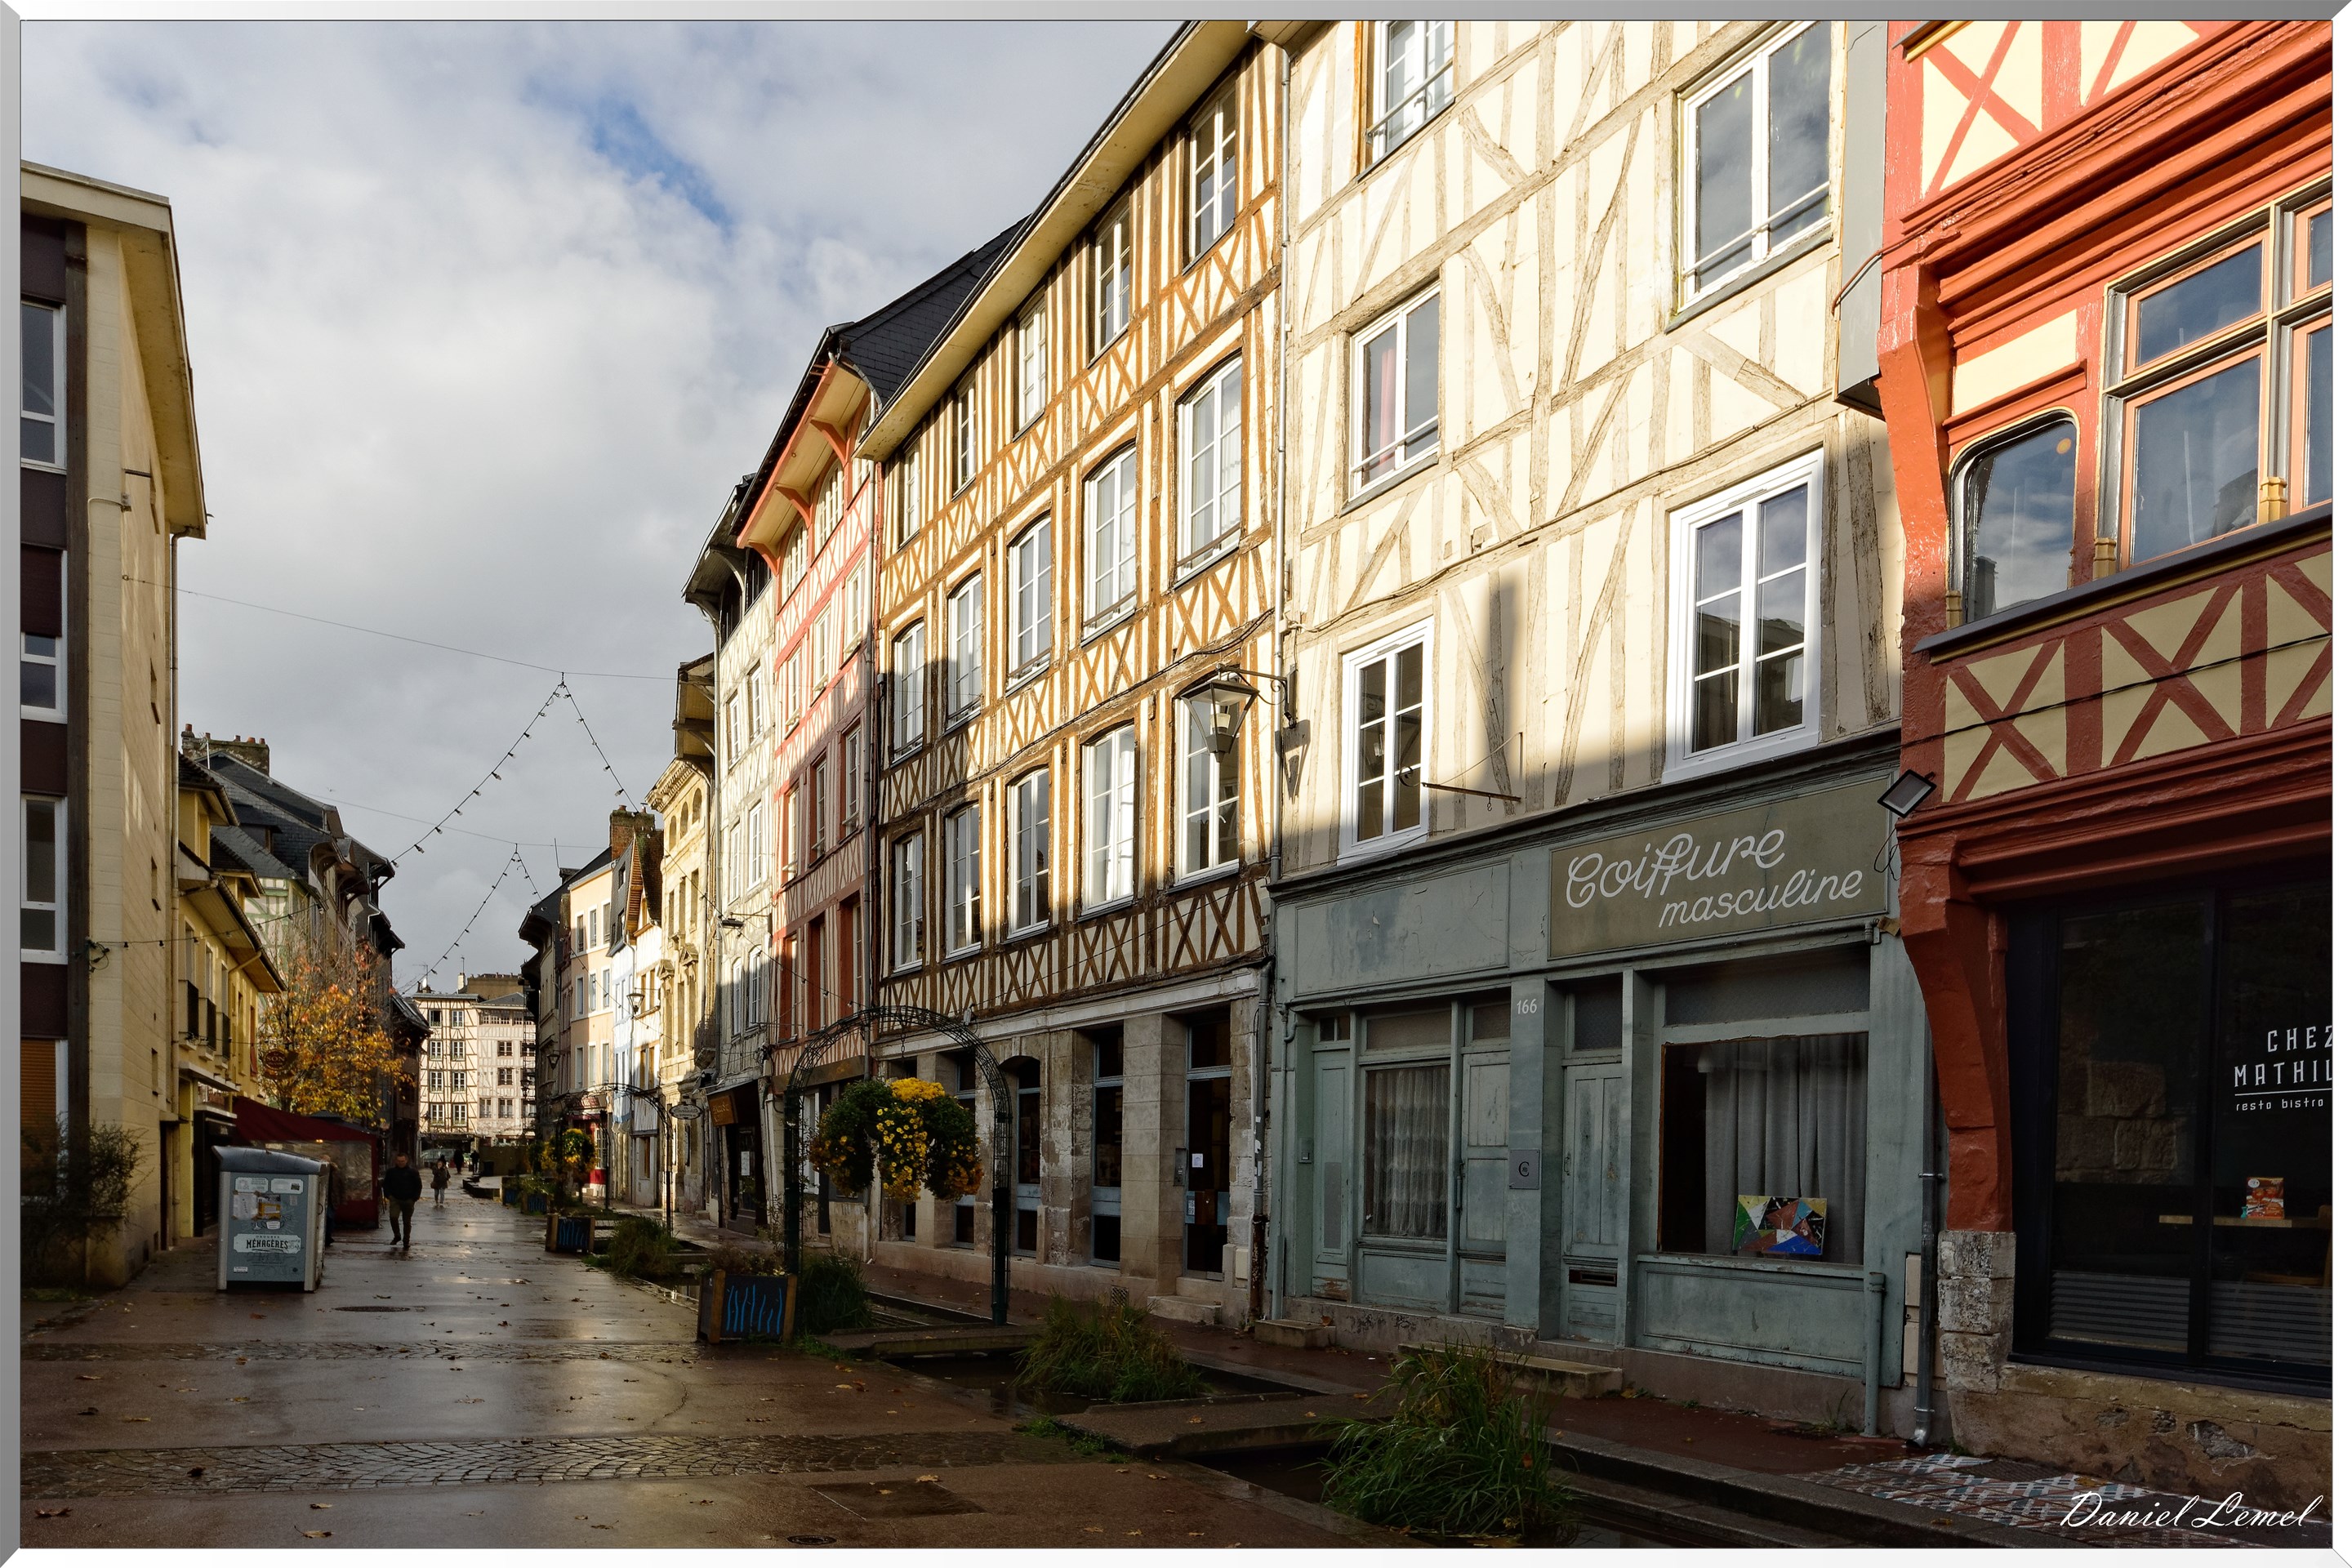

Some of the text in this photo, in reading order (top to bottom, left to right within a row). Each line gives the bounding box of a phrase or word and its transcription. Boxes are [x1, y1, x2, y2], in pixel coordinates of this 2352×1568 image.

[1566, 829, 1786, 908] Coiffure
[1658, 869, 1863, 928] masculine
[1517, 998, 1538, 1014] 166
[2267, 1024, 2333, 1053] CHEZ
[2236, 1097, 2324, 1111] resto bistro
[246, 1238, 288, 1250] MÉNAGÈRES
